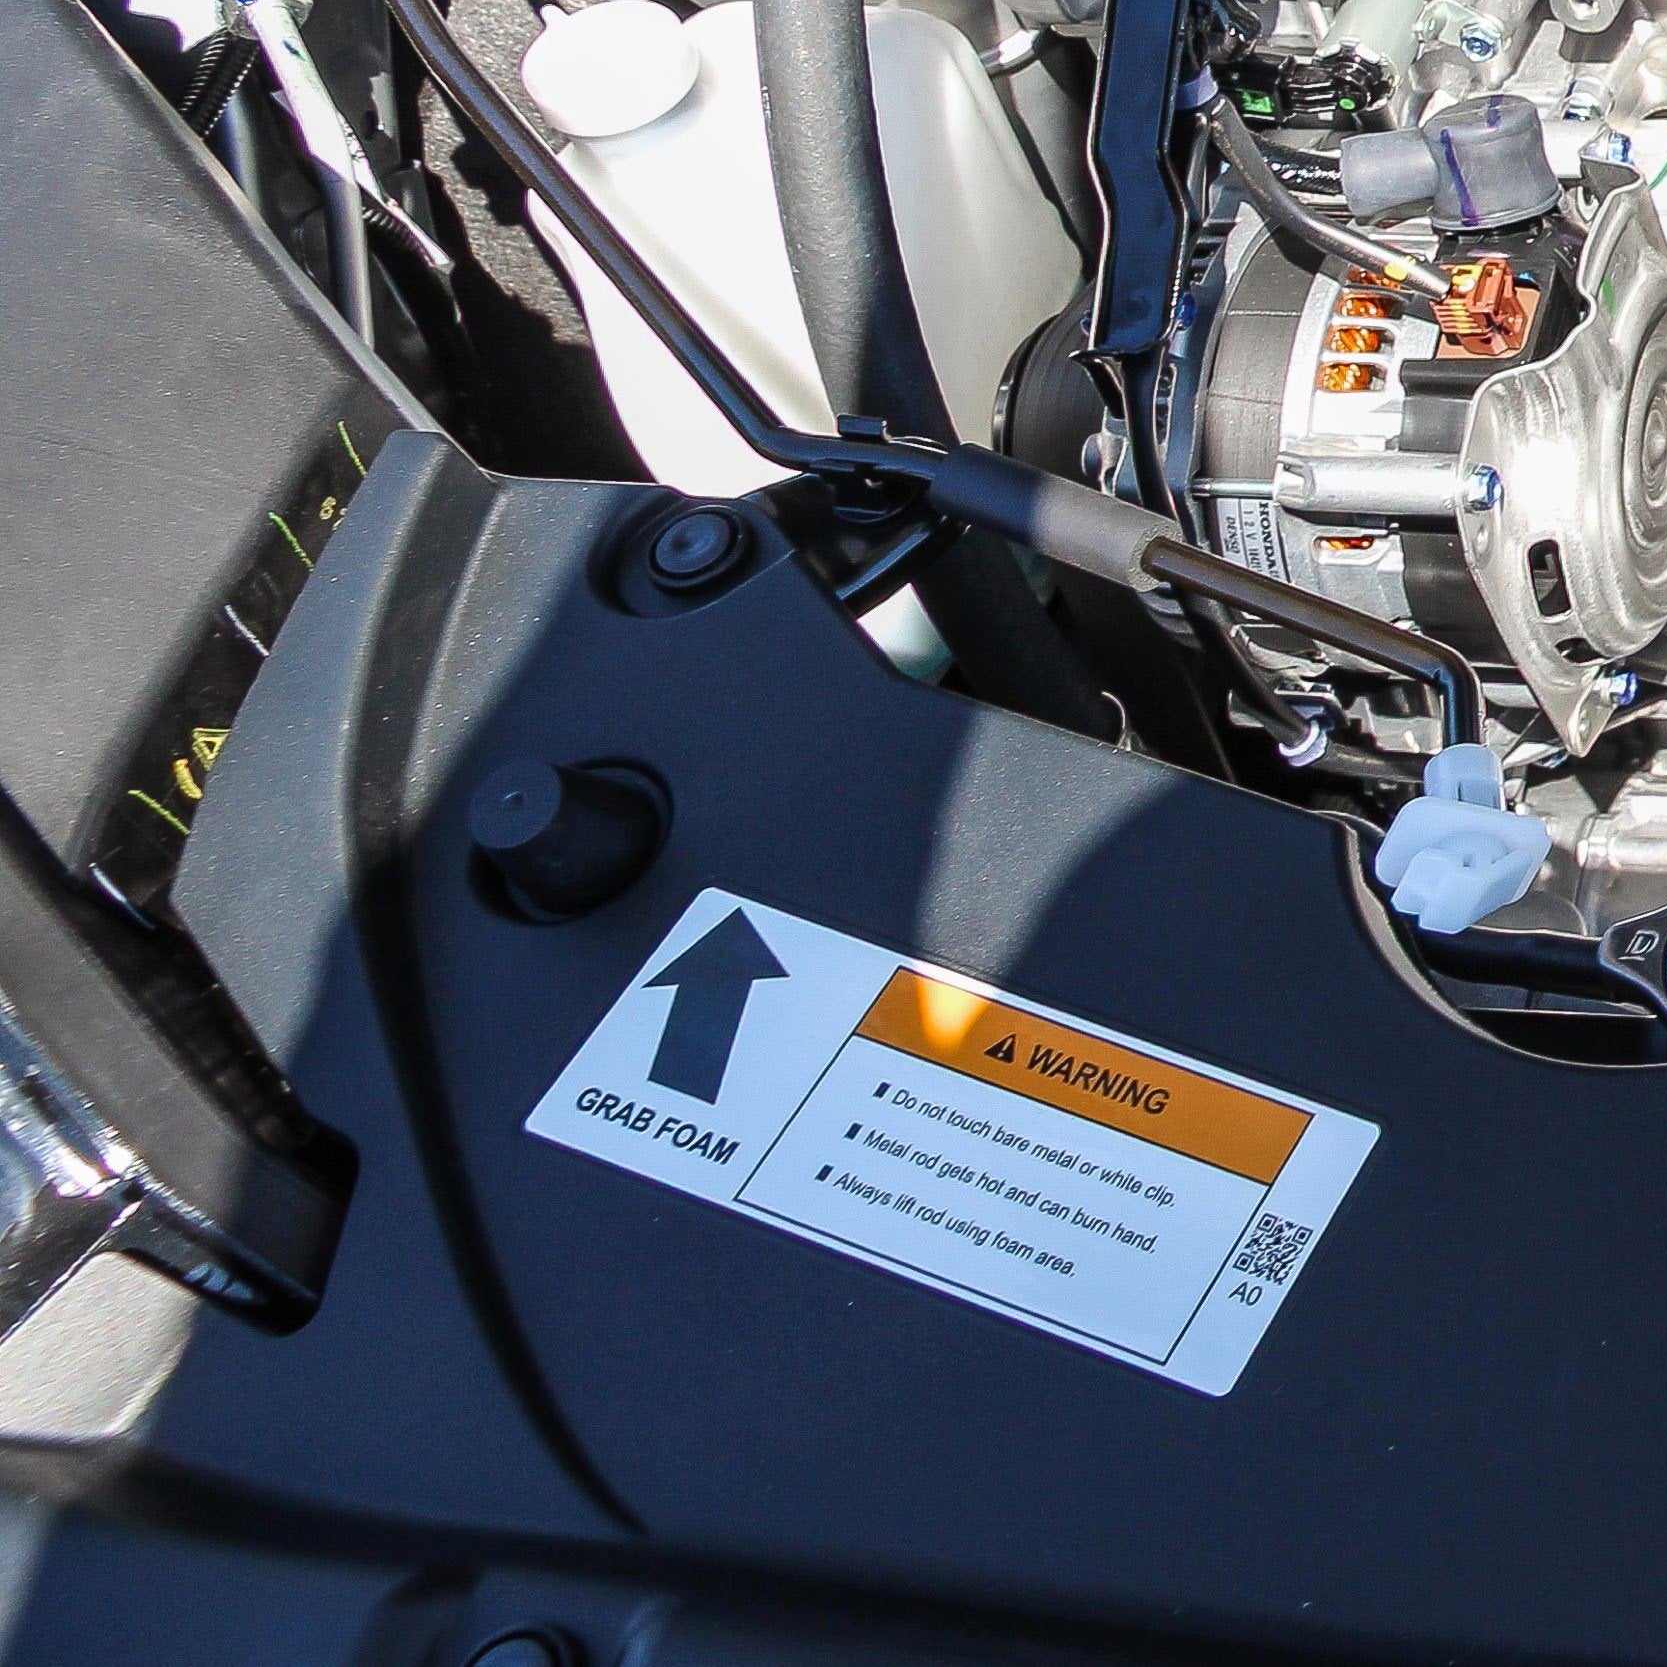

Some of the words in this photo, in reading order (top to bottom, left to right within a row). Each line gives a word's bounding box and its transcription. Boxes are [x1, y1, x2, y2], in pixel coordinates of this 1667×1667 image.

[1226, 517, 1241, 554] DENSO
[1259, 502, 1277, 569] HONDA
[1026, 1043, 1172, 1116] WARNING
[575, 1086, 655, 1134] GRAB
[652, 1115, 741, 1166] FOAM
[890, 1088, 915, 1113] Do
[916, 1098, 946, 1126] not
[948, 1108, 992, 1141] touch
[993, 1122, 1031, 1155] bare
[1032, 1139, 1078, 1171] metal
[1079, 1159, 1100, 1178] or
[1099, 1161, 1142, 1196] white
[1144, 1181, 1177, 1209] clip.
[834, 1171, 892, 1208] Always
[892, 1190, 914, 1216] lift
[914, 1200, 944, 1226] rod
[946, 1214, 989, 1248] using
[990, 1228, 1035, 1263] foam
[863, 1128, 909, 1160] Metal
[909, 1146, 939, 1173] rod
[939, 1158, 975, 1189] gets
[977, 1169, 1005, 1198] hot
[1005, 1183, 1039, 1210] and
[1039, 1197, 1070, 1220] can
[1072, 1202, 1111, 1236] burn
